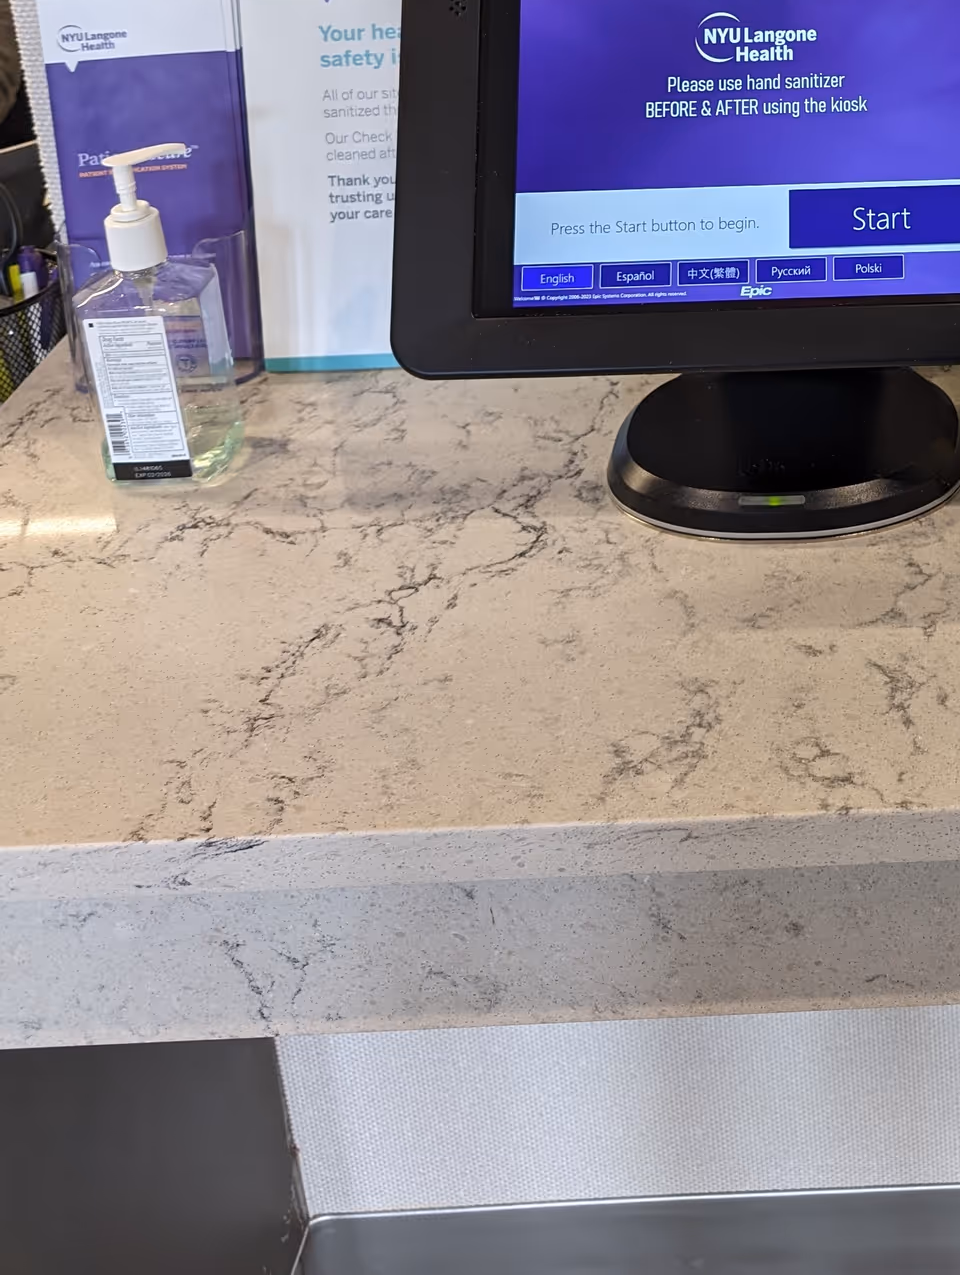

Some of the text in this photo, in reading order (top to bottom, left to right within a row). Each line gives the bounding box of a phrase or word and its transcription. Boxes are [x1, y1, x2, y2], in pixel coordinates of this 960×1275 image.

[61, 30, 127, 43] NYU Langone
[318, 24, 366, 42] Your
[703, 27, 817, 47] NYU Langone
[81, 41, 115, 51] Health
[320, 49, 385, 69] safety
[735, 44, 793, 62] Health
[667, 72, 845, 93] Please use hand sanitizer
[322, 88, 399, 101] All of our sit
[323, 105, 380, 118] sanitized
[645, 96, 868, 119] BEFORE & AFTER using the kiosk
[325, 129, 393, 144] Our Check
[326, 148, 376, 161] cleaned
[327, 174, 370, 187] Thank
[328, 191, 383, 204] trusting
[330, 209, 393, 223] your care
[852, 206, 911, 231] Start
[551, 216, 760, 235] Press the Start button to begin.
[771, 265, 811, 278] Русский
[855, 263, 882, 274] Polski
[540, 273, 574, 286] English
[616, 270, 655, 283] Español
[740, 285, 773, 298] Epic
